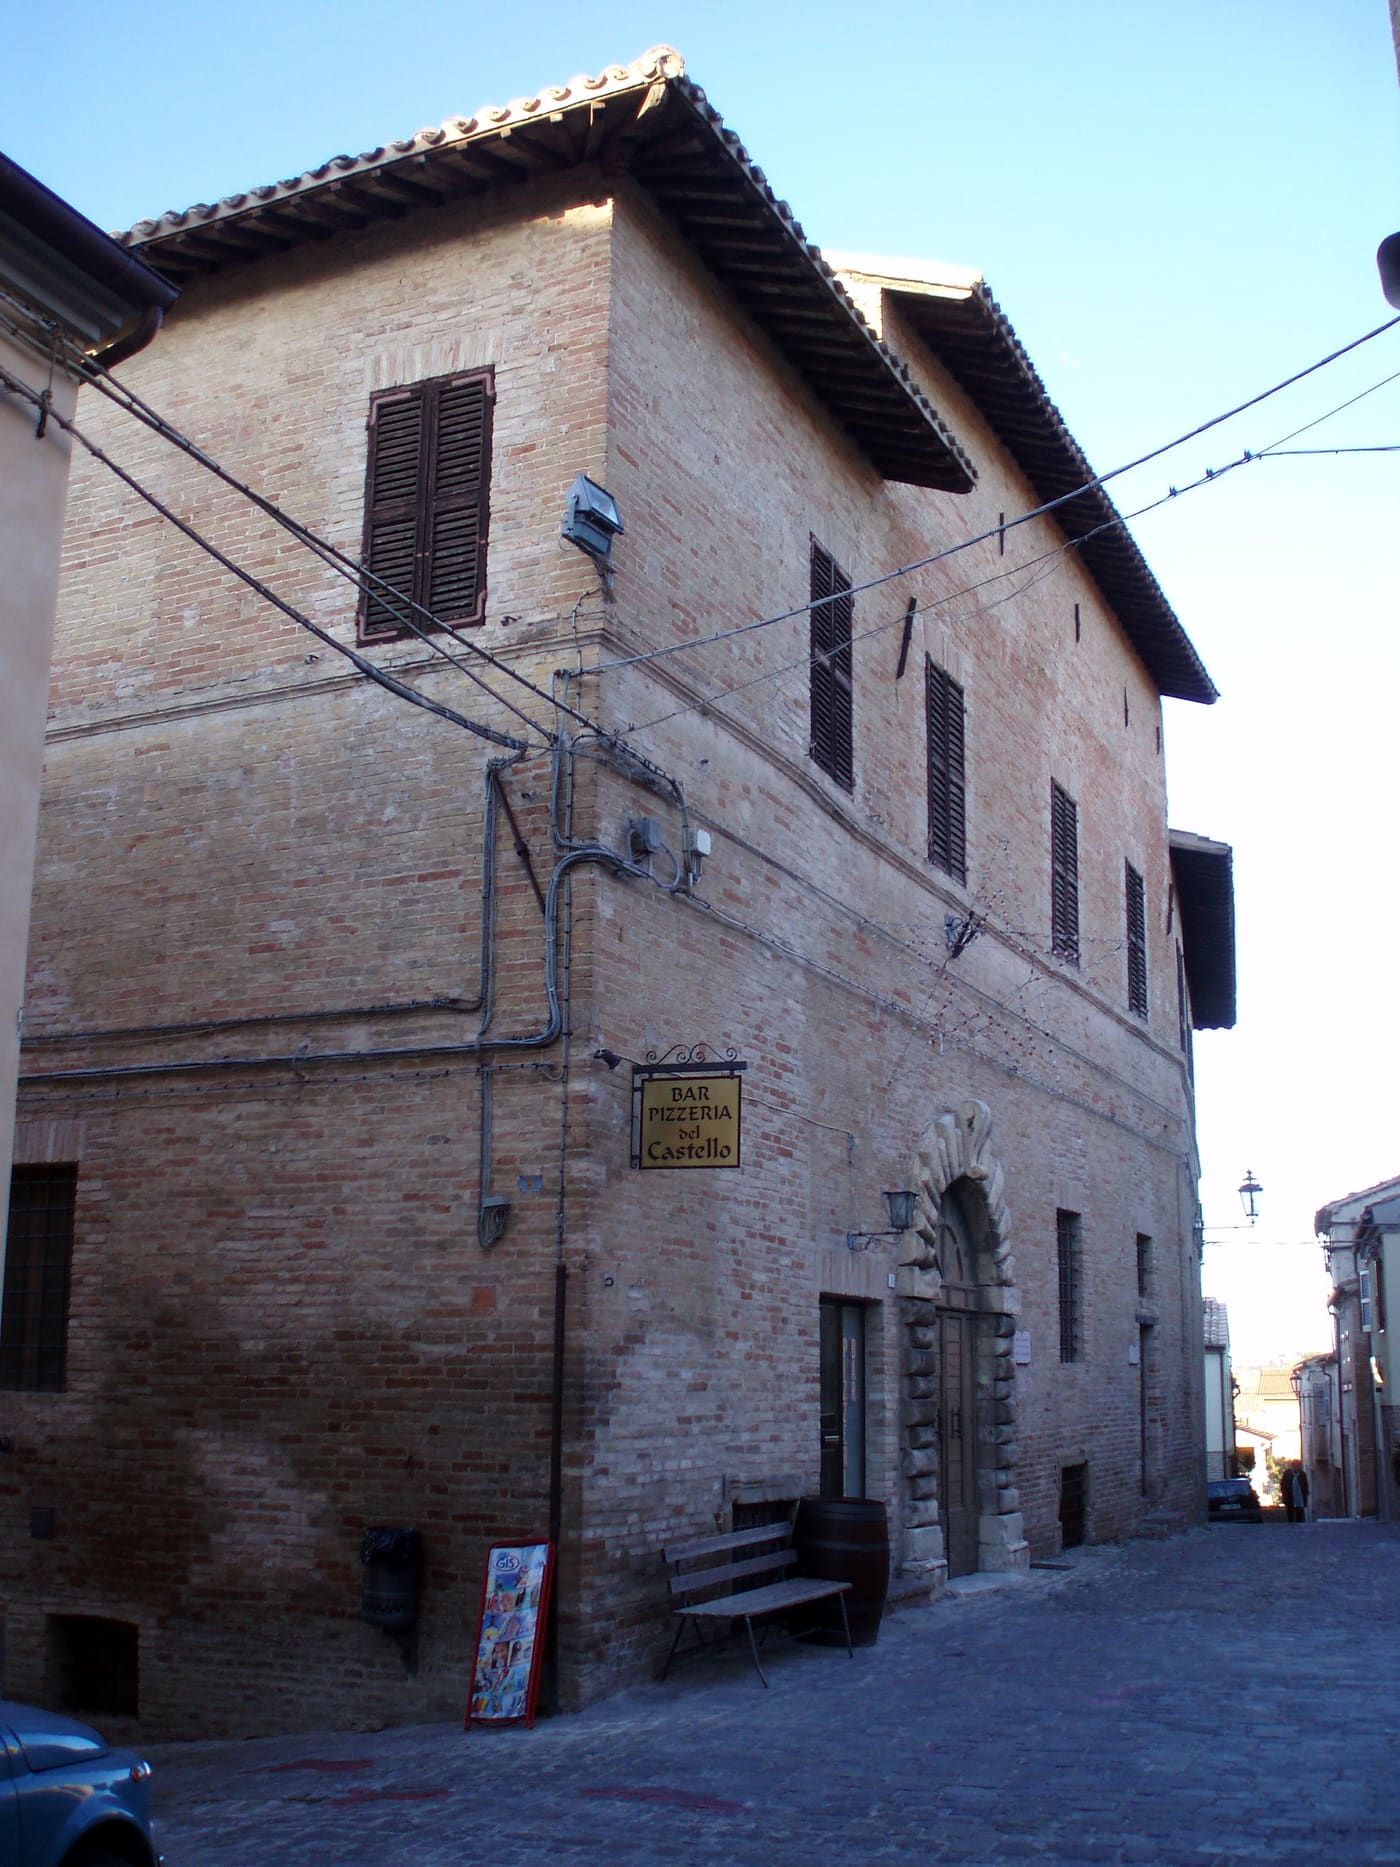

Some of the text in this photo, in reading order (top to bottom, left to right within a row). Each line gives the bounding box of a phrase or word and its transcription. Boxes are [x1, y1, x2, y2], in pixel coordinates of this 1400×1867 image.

[672, 1086, 710, 1102] BAR
[648, 1105, 733, 1122] PIZZERIA
[679, 1125, 700, 1140] del
[647, 1137, 732, 1160] Castello
